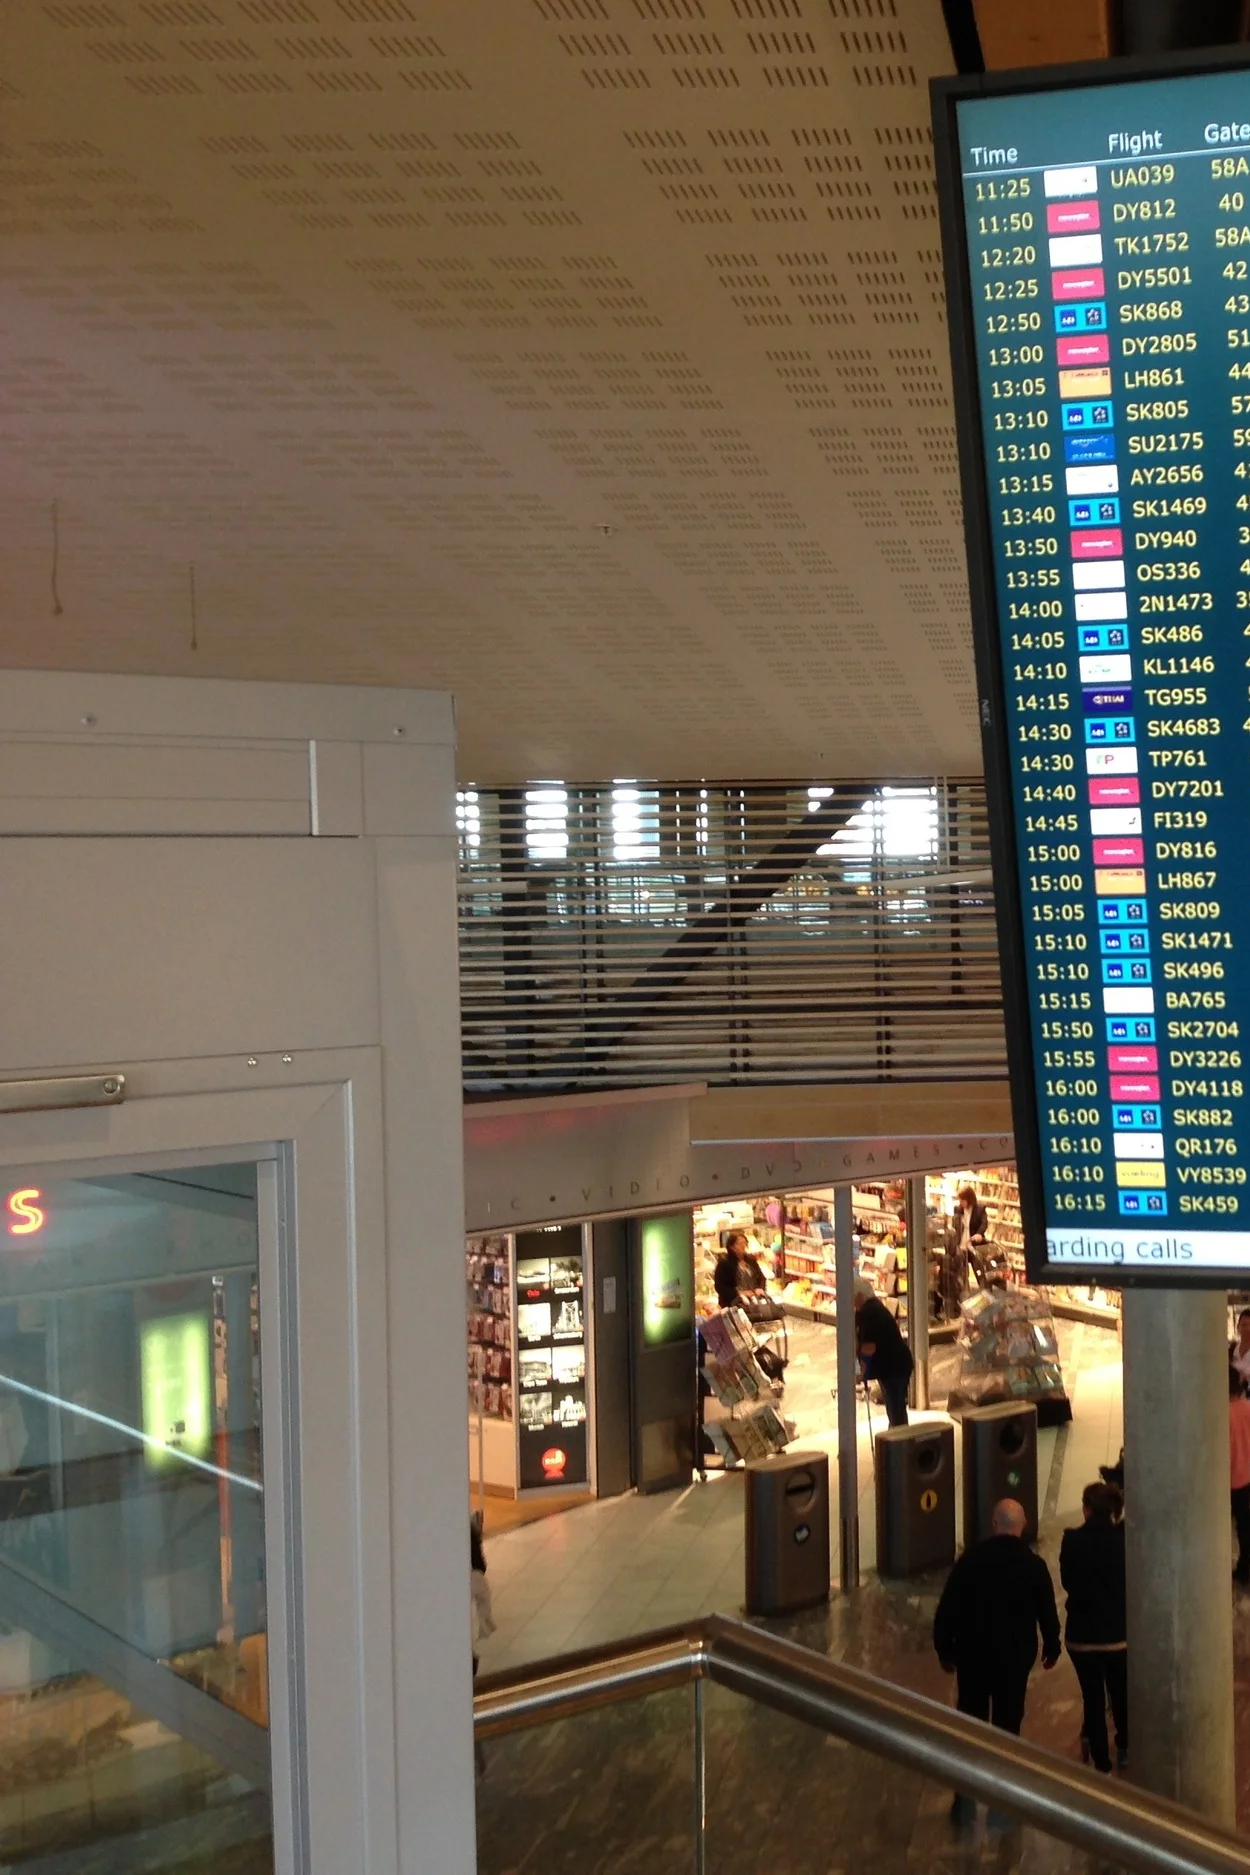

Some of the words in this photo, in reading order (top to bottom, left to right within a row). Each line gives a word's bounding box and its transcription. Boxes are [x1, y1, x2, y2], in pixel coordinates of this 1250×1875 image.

[969, 145, 1019, 166] Time
[1107, 129, 1164, 156] Flight
[975, 176, 1031, 201] 11:25
[1109, 163, 1175, 188] UA039
[1210, 155, 1250, 179] 58A
[978, 211, 1034, 235] 11:50
[1112, 197, 1176, 223] DY812
[1218, 190, 1245, 212] 40
[981, 244, 1036, 268] 12:20
[1113, 230, 1189, 256] TK1752
[983, 277, 1039, 301] 12:25
[1117, 265, 1192, 290] DY5501
[1222, 259, 1248, 280] 42
[986, 311, 1042, 334] 12:50
[1118, 299, 1183, 324] SK868
[1223, 293, 1250, 314] 43
[988, 344, 1044, 366] 13:00
[1121, 331, 1198, 356] DY2805
[991, 376, 1046, 399] 13:05
[1123, 366, 1185, 389] LH861
[993, 408, 1049, 431] 13:10
[1125, 398, 1189, 422] SK805
[996, 441, 1052, 463] 13:10
[1127, 430, 1204, 454] SU2175
[998, 473, 1054, 495] 13:15
[1129, 463, 1204, 486] AY2656
[1001, 505, 1056, 526] 13:40
[1131, 495, 1207, 519] SK1469
[1003, 536, 1059, 557] 13:50
[1134, 528, 1198, 550] DY940
[1006, 568, 1061, 589] 13:55
[1135, 560, 1202, 582] OS336
[1008, 599, 1063, 620] 14:00
[1138, 591, 1214, 614] 2N1473
[1013, 661, 1068, 681] 14:10
[1142, 654, 1215, 676] KL1146
[1015, 691, 1070, 712] 14:15
[1143, 686, 1208, 707] TG955
[1018, 722, 1072, 742] 14:30
[1146, 716, 1221, 738] SK4683
[1022, 783, 1077, 802] 14:40
[1151, 779, 1224, 799] DY7201
[1025, 813, 1079, 833] 14:45
[1153, 810, 1208, 829] FI319
[1029, 873, 1083, 892] 15:00
[1157, 870, 1217, 890] LH867
[1031, 903, 1085, 922] 15:05
[1158, 900, 1221, 920] SK809
[1033, 932, 1088, 951] 15:10
[1160, 930, 1233, 950] SK1471
[1038, 991, 1092, 1010] 15:15
[1165, 990, 1226, 1009] BA765
[1041, 1020, 1094, 1039] 15:50
[1166, 1020, 1240, 1039] SK2704
[1047, 1107, 1100, 1126] 16:00
[1172, 1108, 1233, 1127] SK882
[1049, 1135, 1103, 1154] 16:10
[1174, 1136, 1238, 1158] QR176
[581, 1174, 691, 1202] VIDEO
[842, 1143, 941, 1168] GAMES
[1052, 1164, 1105, 1183] 16:10
[1176, 1166, 1248, 1185] VY8539
[1054, 1192, 1106, 1211] 16:15
[1178, 1194, 1239, 1213] SK459
[1048, 1236, 1125, 1264] arding
[1136, 1238, 1193, 1260] calls
